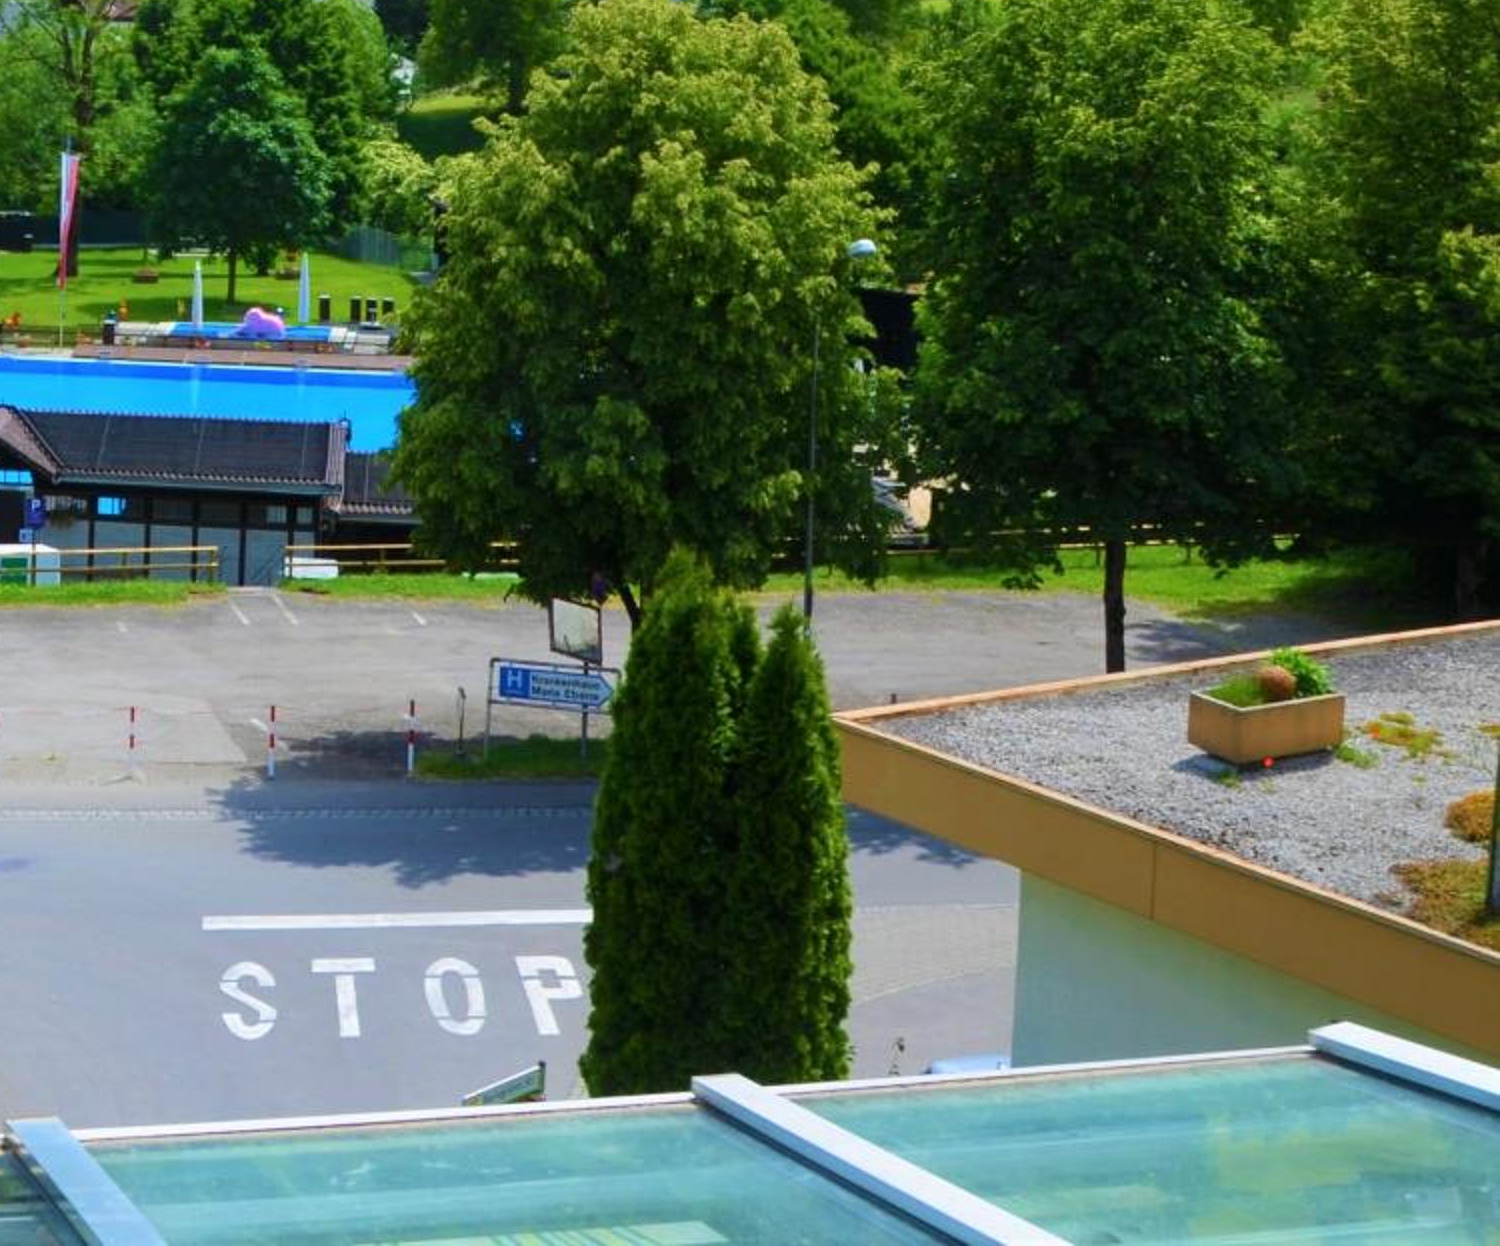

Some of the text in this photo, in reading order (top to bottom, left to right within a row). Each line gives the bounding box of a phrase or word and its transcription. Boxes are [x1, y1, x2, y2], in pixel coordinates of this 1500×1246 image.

[31, 499, 41, 513] P
[507, 669, 522, 688] H
[219, 955, 583, 1041] STOP
